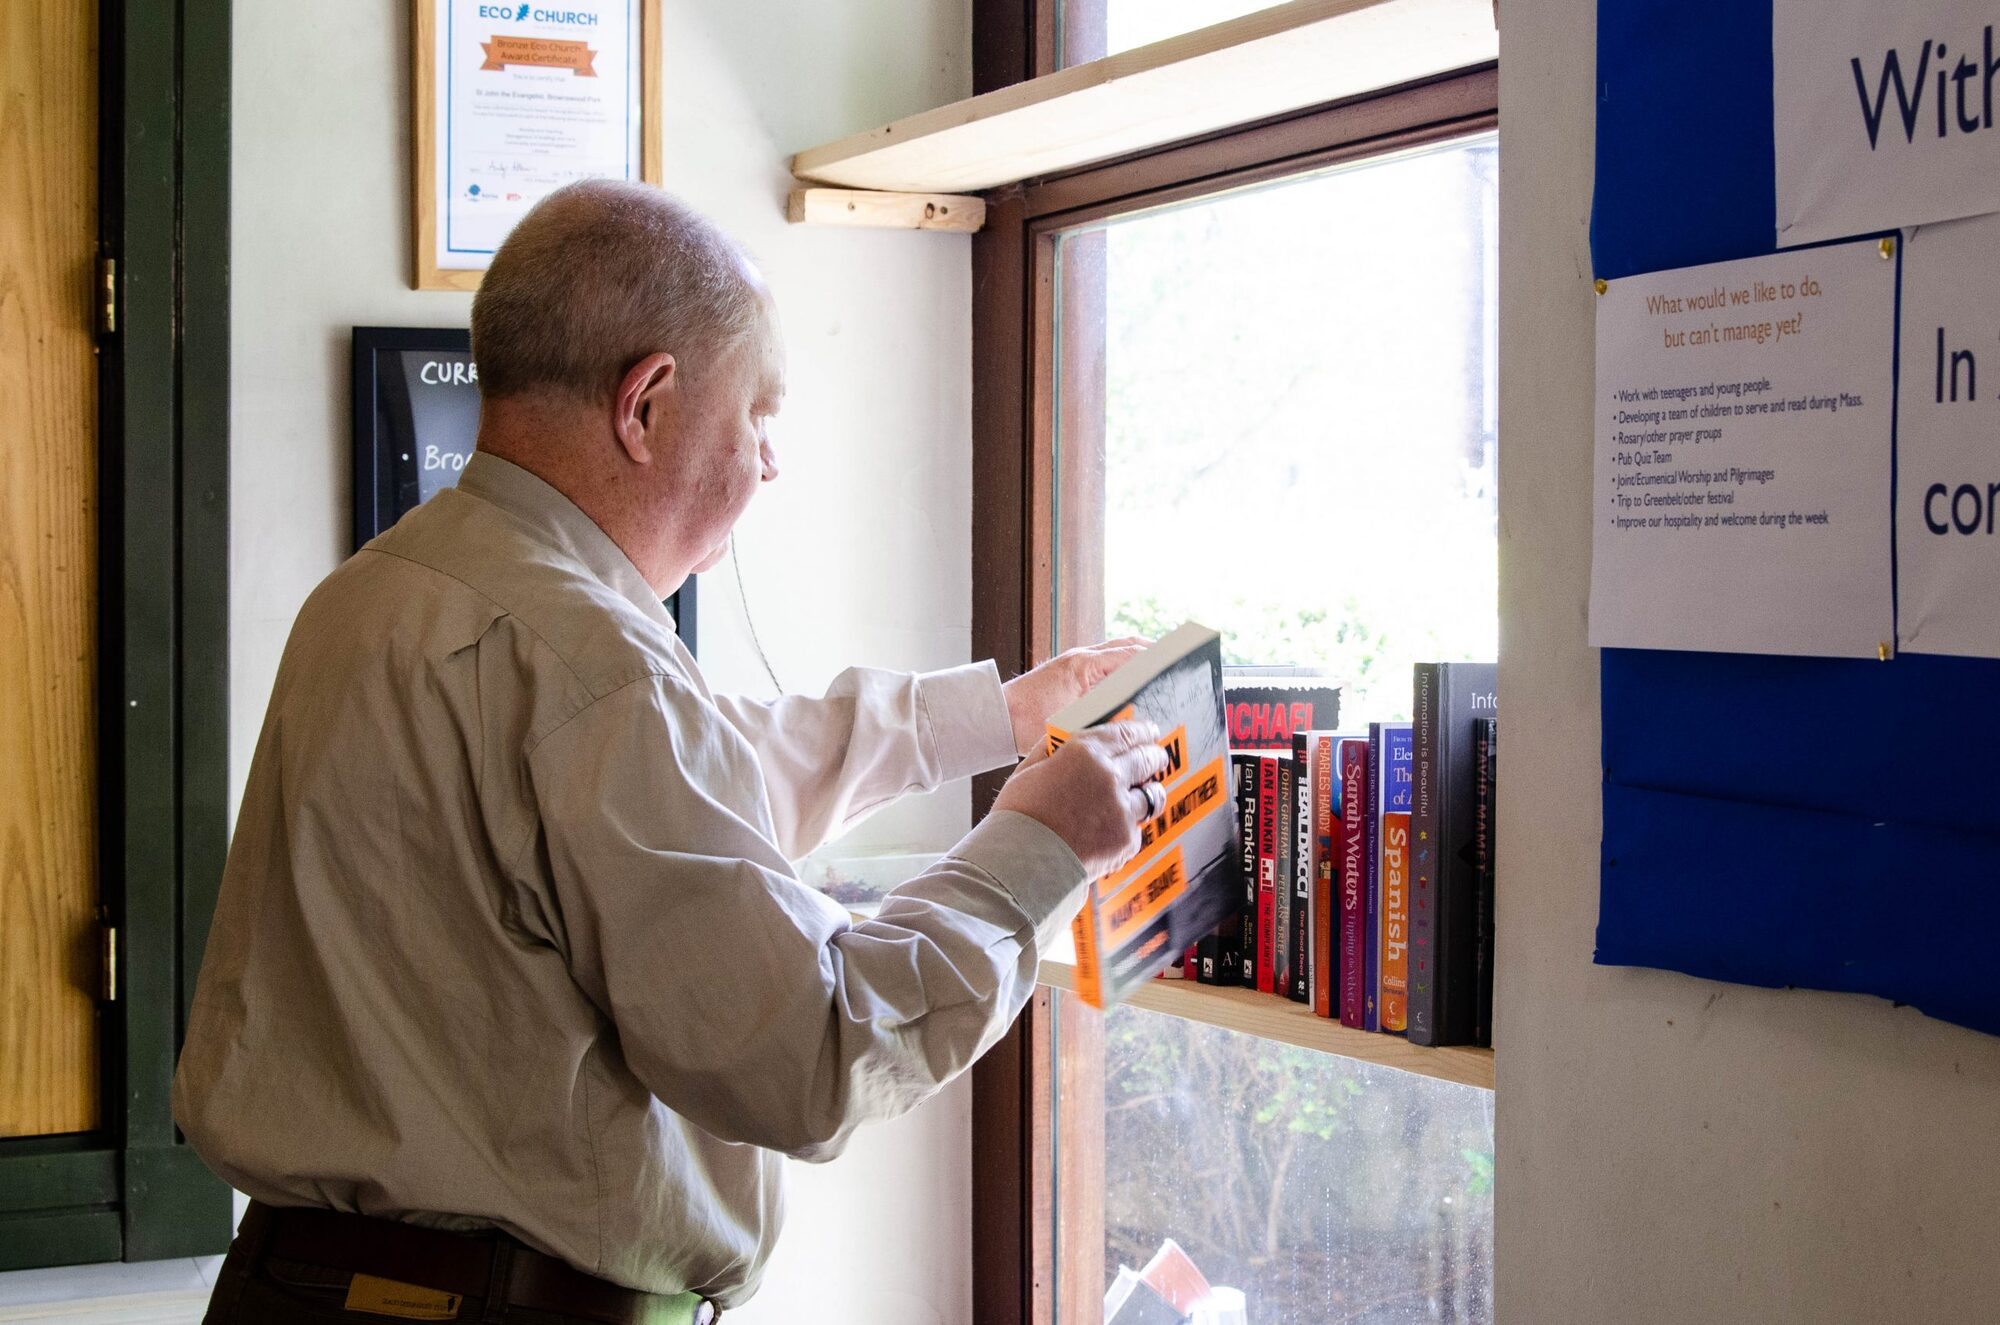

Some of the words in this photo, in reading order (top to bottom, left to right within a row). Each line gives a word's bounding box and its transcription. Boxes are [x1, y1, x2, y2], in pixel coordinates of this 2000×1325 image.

[479, 5, 512, 20] ECO
[533, 9, 598, 26] CHURCH
[497, 39, 528, 50] Bronze
[530, 41, 547, 51] Eco
[549, 43, 581, 54] Church
[500, 51, 530, 61] Award
[531, 54, 577, 64] Certificate
[1646, 294, 1682, 315] What
[1686, 286, 1725, 310] would
[1730, 289, 1749, 306] we
[1753, 281, 1776, 303] like
[1781, 283, 1795, 299] to
[1800, 275, 1822, 298] do,
[1664, 328, 1685, 348] but
[1689, 323, 1719, 345] can't
[1723, 321, 1772, 344] manage
[1776, 312, 1802, 342] yet?
[1936, 327, 1976, 403] In
[1618, 388, 1640, 402] Work
[1642, 387, 1658, 401] with
[1660, 386, 1698, 401] teenagers
[1699, 382, 1714, 397] and
[1716, 382, 1741, 399] young
[1619, 409, 1660, 425] Developing
[1662, 412, 1666, 421] a
[1668, 409, 1688, 421] team
[1690, 405, 1699, 418] of
[1700, 403, 1732, 418] children
[1734, 404, 1744, 416] to
[1745, 403, 1768, 414] serve
[1770, 398, 1786, 413] and
[1787, 395, 1807, 411] read
[1809, 395, 1837, 412] during
[1618, 429, 1667, 447] Rosary/other
[1669, 429, 1694, 445] prayer
[1695, 428, 1722, 444] groups
[1618, 451, 1632, 466] Pub
[1634, 451, 1652, 467] Quiz
[1653, 450, 1673, 464] Team
[1616, 470, 1677, 490] Joint/Ecumenical
[1678, 469, 1711, 486] Worship
[1713, 468, 1728, 483] and
[1730, 467, 1775, 485] Pilgrimages
[1617, 494, 1632, 510] Trip
[1633, 495, 1642, 507] to
[1644, 491, 1705, 507] Greenbelt/other
[1707, 490, 1734, 504] festival
[1616, 515, 1647, 531] Improve
[1648, 518, 1662, 528] our
[1664, 513, 1702, 531] hospitality
[1704, 512, 1719, 526] and
[1721, 512, 1757, 526] welcome
[1759, 511, 1786, 529] during
[1788, 510, 1803, 525] the
[1805, 509, 1829, 525] week
[1421, 672, 1429, 744] Information
[1319, 740, 1330, 790] CHARLES
[1421, 747, 1429, 757] is
[1477, 741, 1488, 795] DAVID
[1245, 764, 1255, 791] Ian
[1264, 763, 1274, 789] IAN
[1279, 767, 1290, 801] JOHN
[1421, 761, 1429, 817] Beautiful
[1319, 794, 1330, 832] HANDY
[1346, 763, 1362, 830] Sarah
[1393, 789, 1406, 805] of
[1244, 797, 1256, 872] Rankin
[1263, 796, 1274, 854] RANKIN
[1279, 804, 1289, 859] GRISHAM
[1297, 785, 1309, 899] BALDACCI
[1476, 804, 1487, 872] MAMET
[1346, 833, 1362, 910] Waters
[1277, 874, 1287, 918] PELICAN
[1384, 827, 1408, 961] Spanish
[1277, 925, 1286, 956] BRIEF
[1345, 913, 1356, 955] Tipping
[1347, 970, 1356, 1003] Velvet
[1383, 976, 1406, 988] Collins
